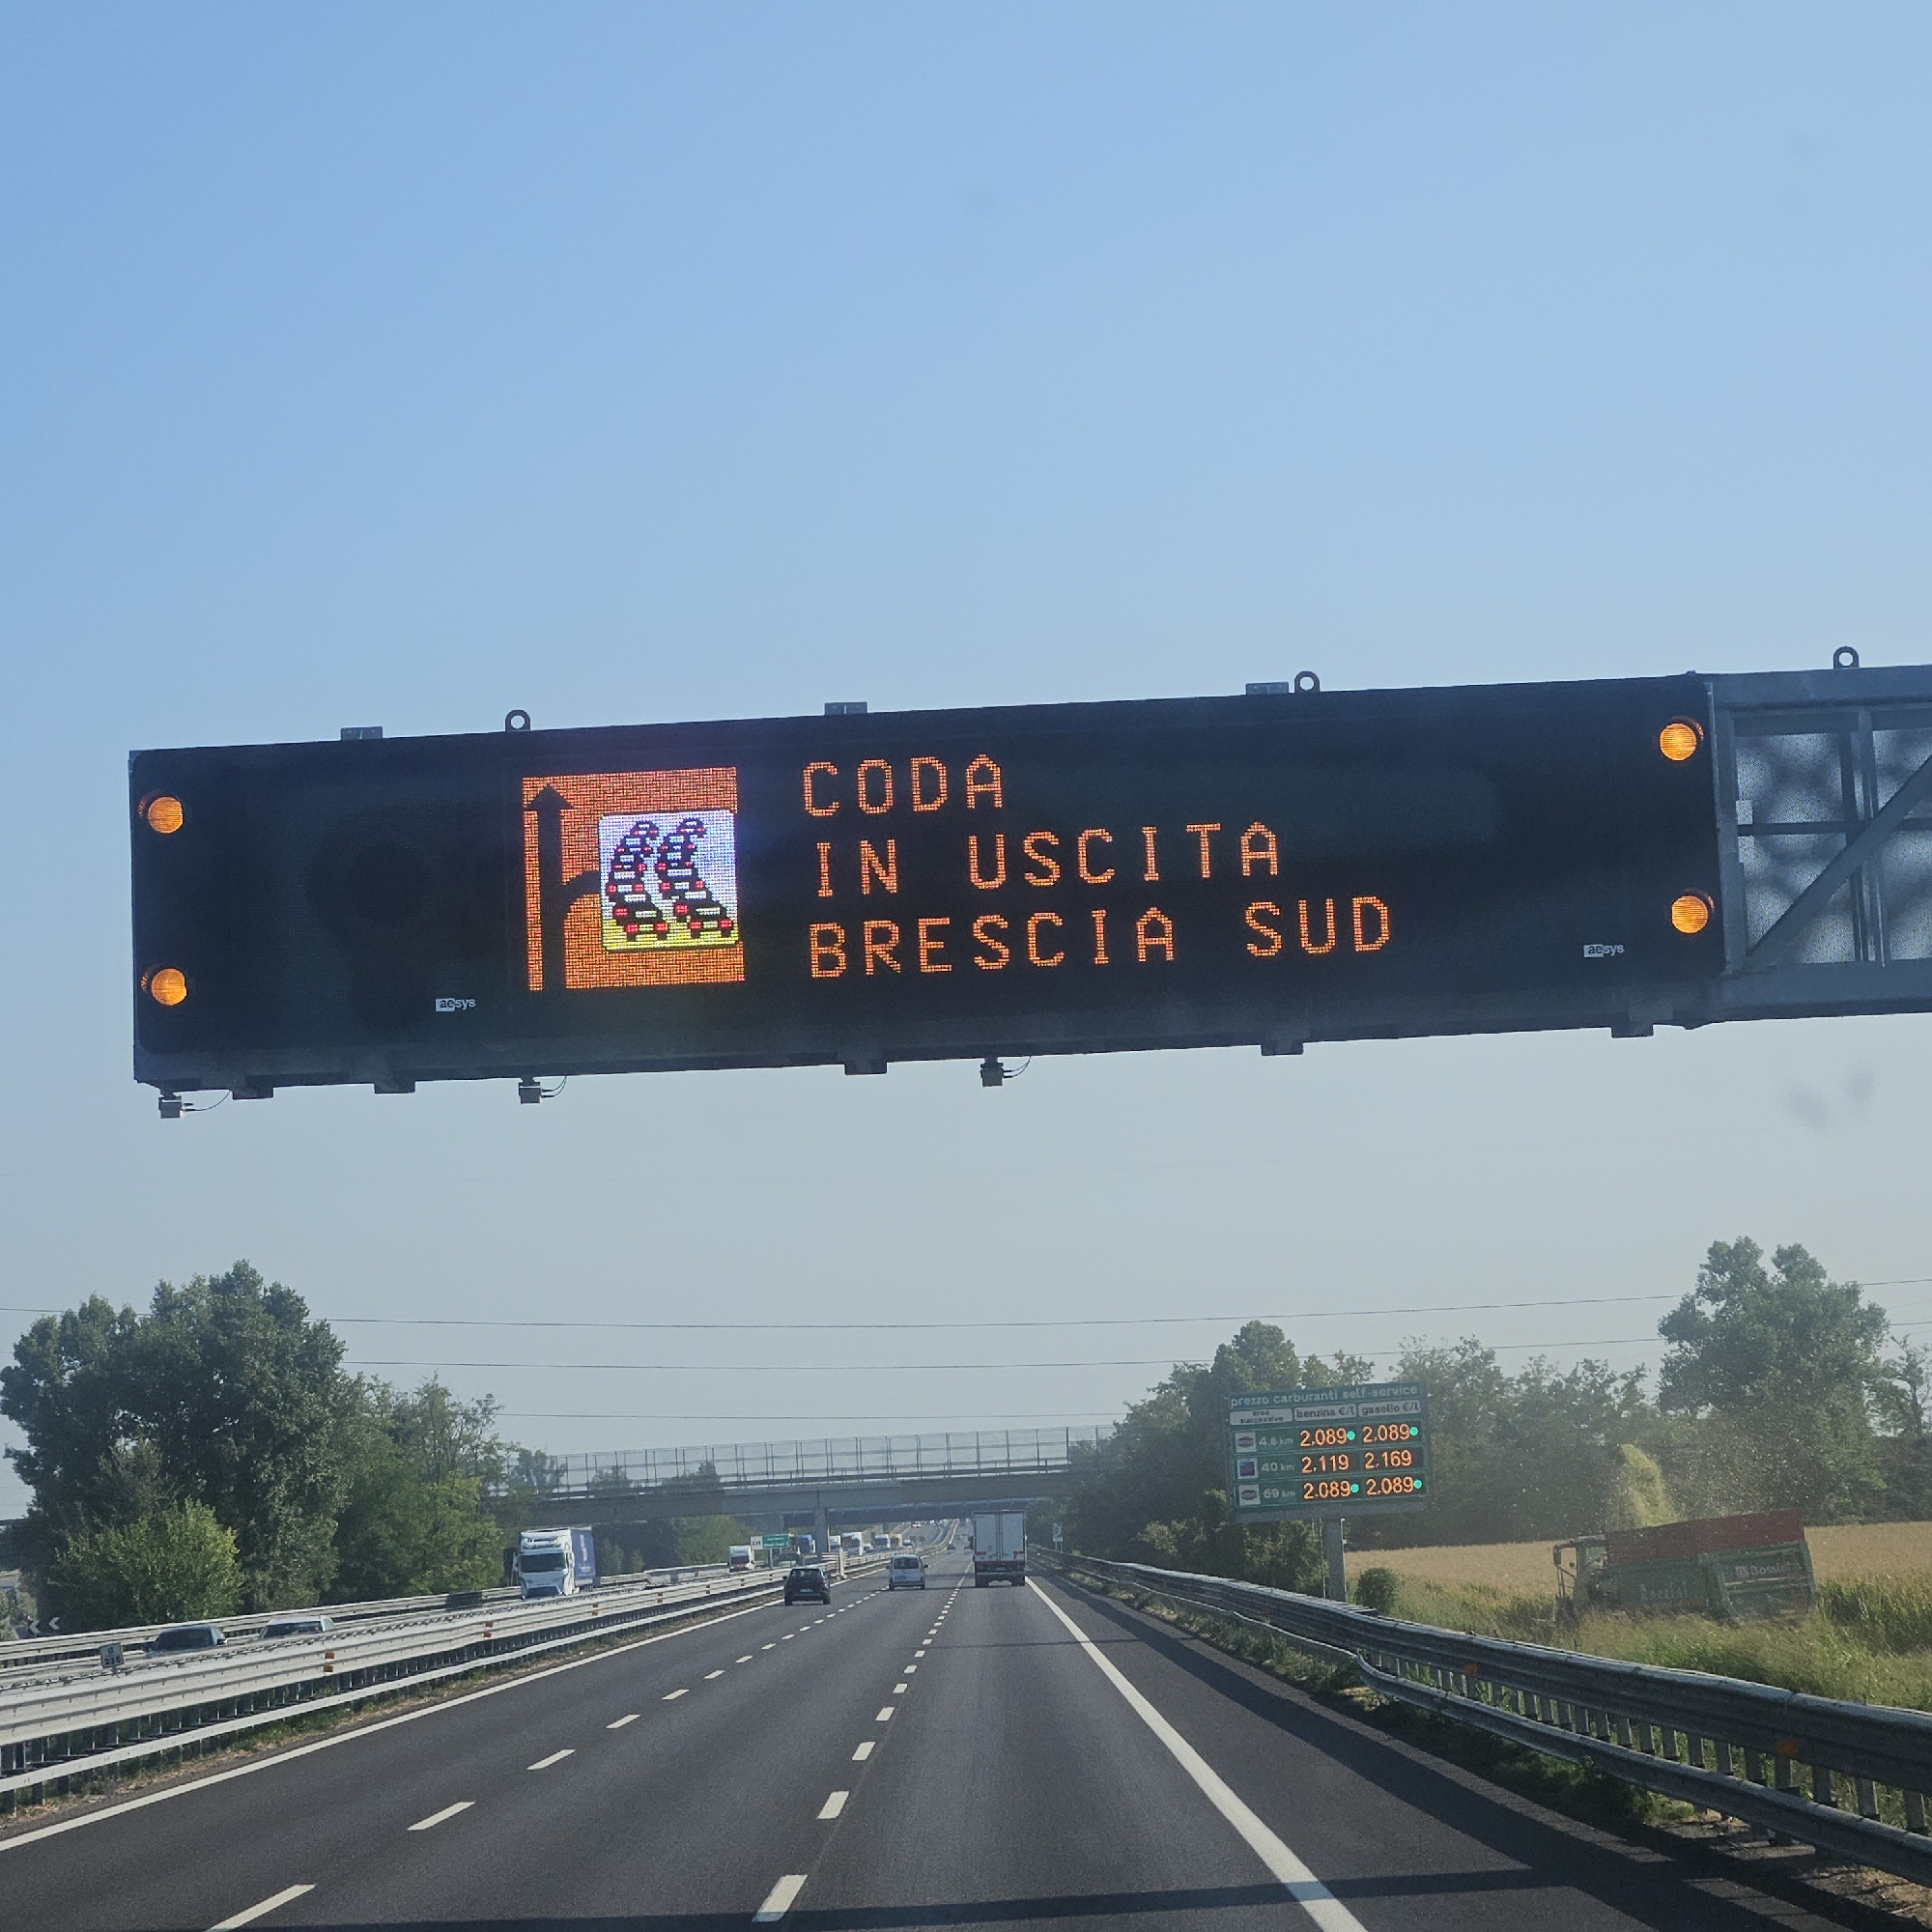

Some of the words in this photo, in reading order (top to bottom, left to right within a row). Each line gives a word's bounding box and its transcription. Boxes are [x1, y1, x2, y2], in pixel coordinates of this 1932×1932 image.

[802, 753, 1003, 817] CODA
[815, 838, 898, 897] IN
[969, 821, 1280, 890] USCITA
[809, 906, 1175, 979] BRESCIA
[1244, 895, 1391, 957] SUD
[1586, 944, 1625, 957] aesys
[437, 998, 476, 1010] aesys
[1231, 1396, 1269, 1408] prezzo
[1273, 1390, 1338, 1405] carburanti
[1343, 1385, 1418, 1399] self-service
[1296, 1406, 1336, 1418] benzina
[1362, 1403, 1401, 1415] gasolio
[1279, 1436, 1293, 1445] km
[1299, 1428, 1348, 1447] 2.089
[1362, 1423, 1410, 1443] 2.089
[1261, 1462, 1278, 1472] 40
[1301, 1454, 1350, 1474] 2.119
[1364, 1450, 1412, 1469] 2.169
[1264, 1488, 1279, 1499] 69
[1303, 1480, 1351, 1500] 2.089
[1365, 1476, 1414, 1496] 2.089
